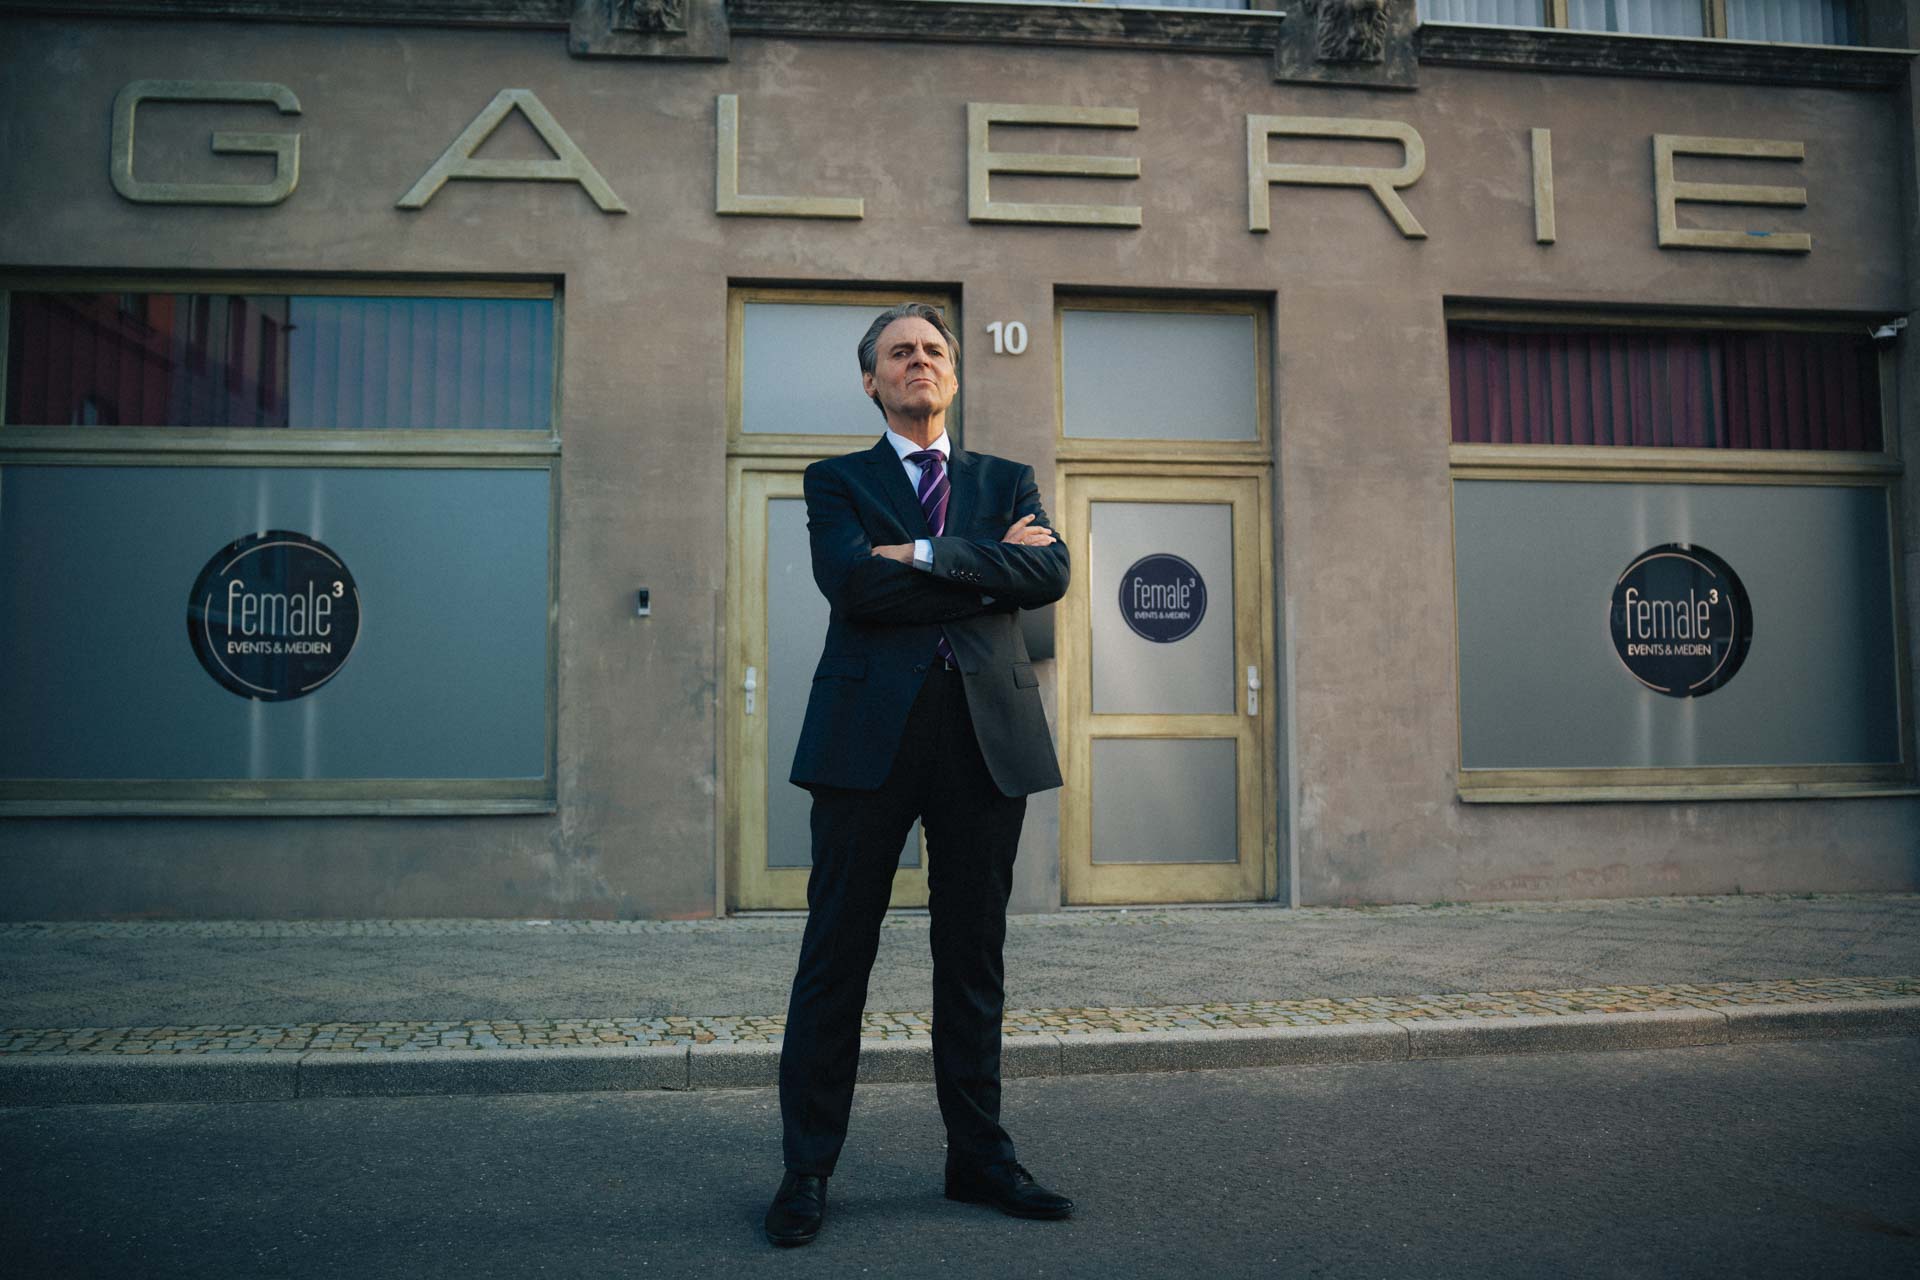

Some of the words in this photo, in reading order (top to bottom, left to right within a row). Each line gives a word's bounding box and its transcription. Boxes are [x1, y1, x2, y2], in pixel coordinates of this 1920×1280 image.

[110, 79, 1812, 252] GALERIE
[986, 321, 1028, 354] 10
[1134, 611, 1158, 619] EVENTS
[227, 641, 271, 654] EVENTS
[273, 641, 282, 654] &
[284, 641, 331, 654] MEDIEN
[1628, 643, 1664, 656] EVENTS
[1665, 643, 1672, 656] &
[1674, 643, 1711, 656] MEDIEN
